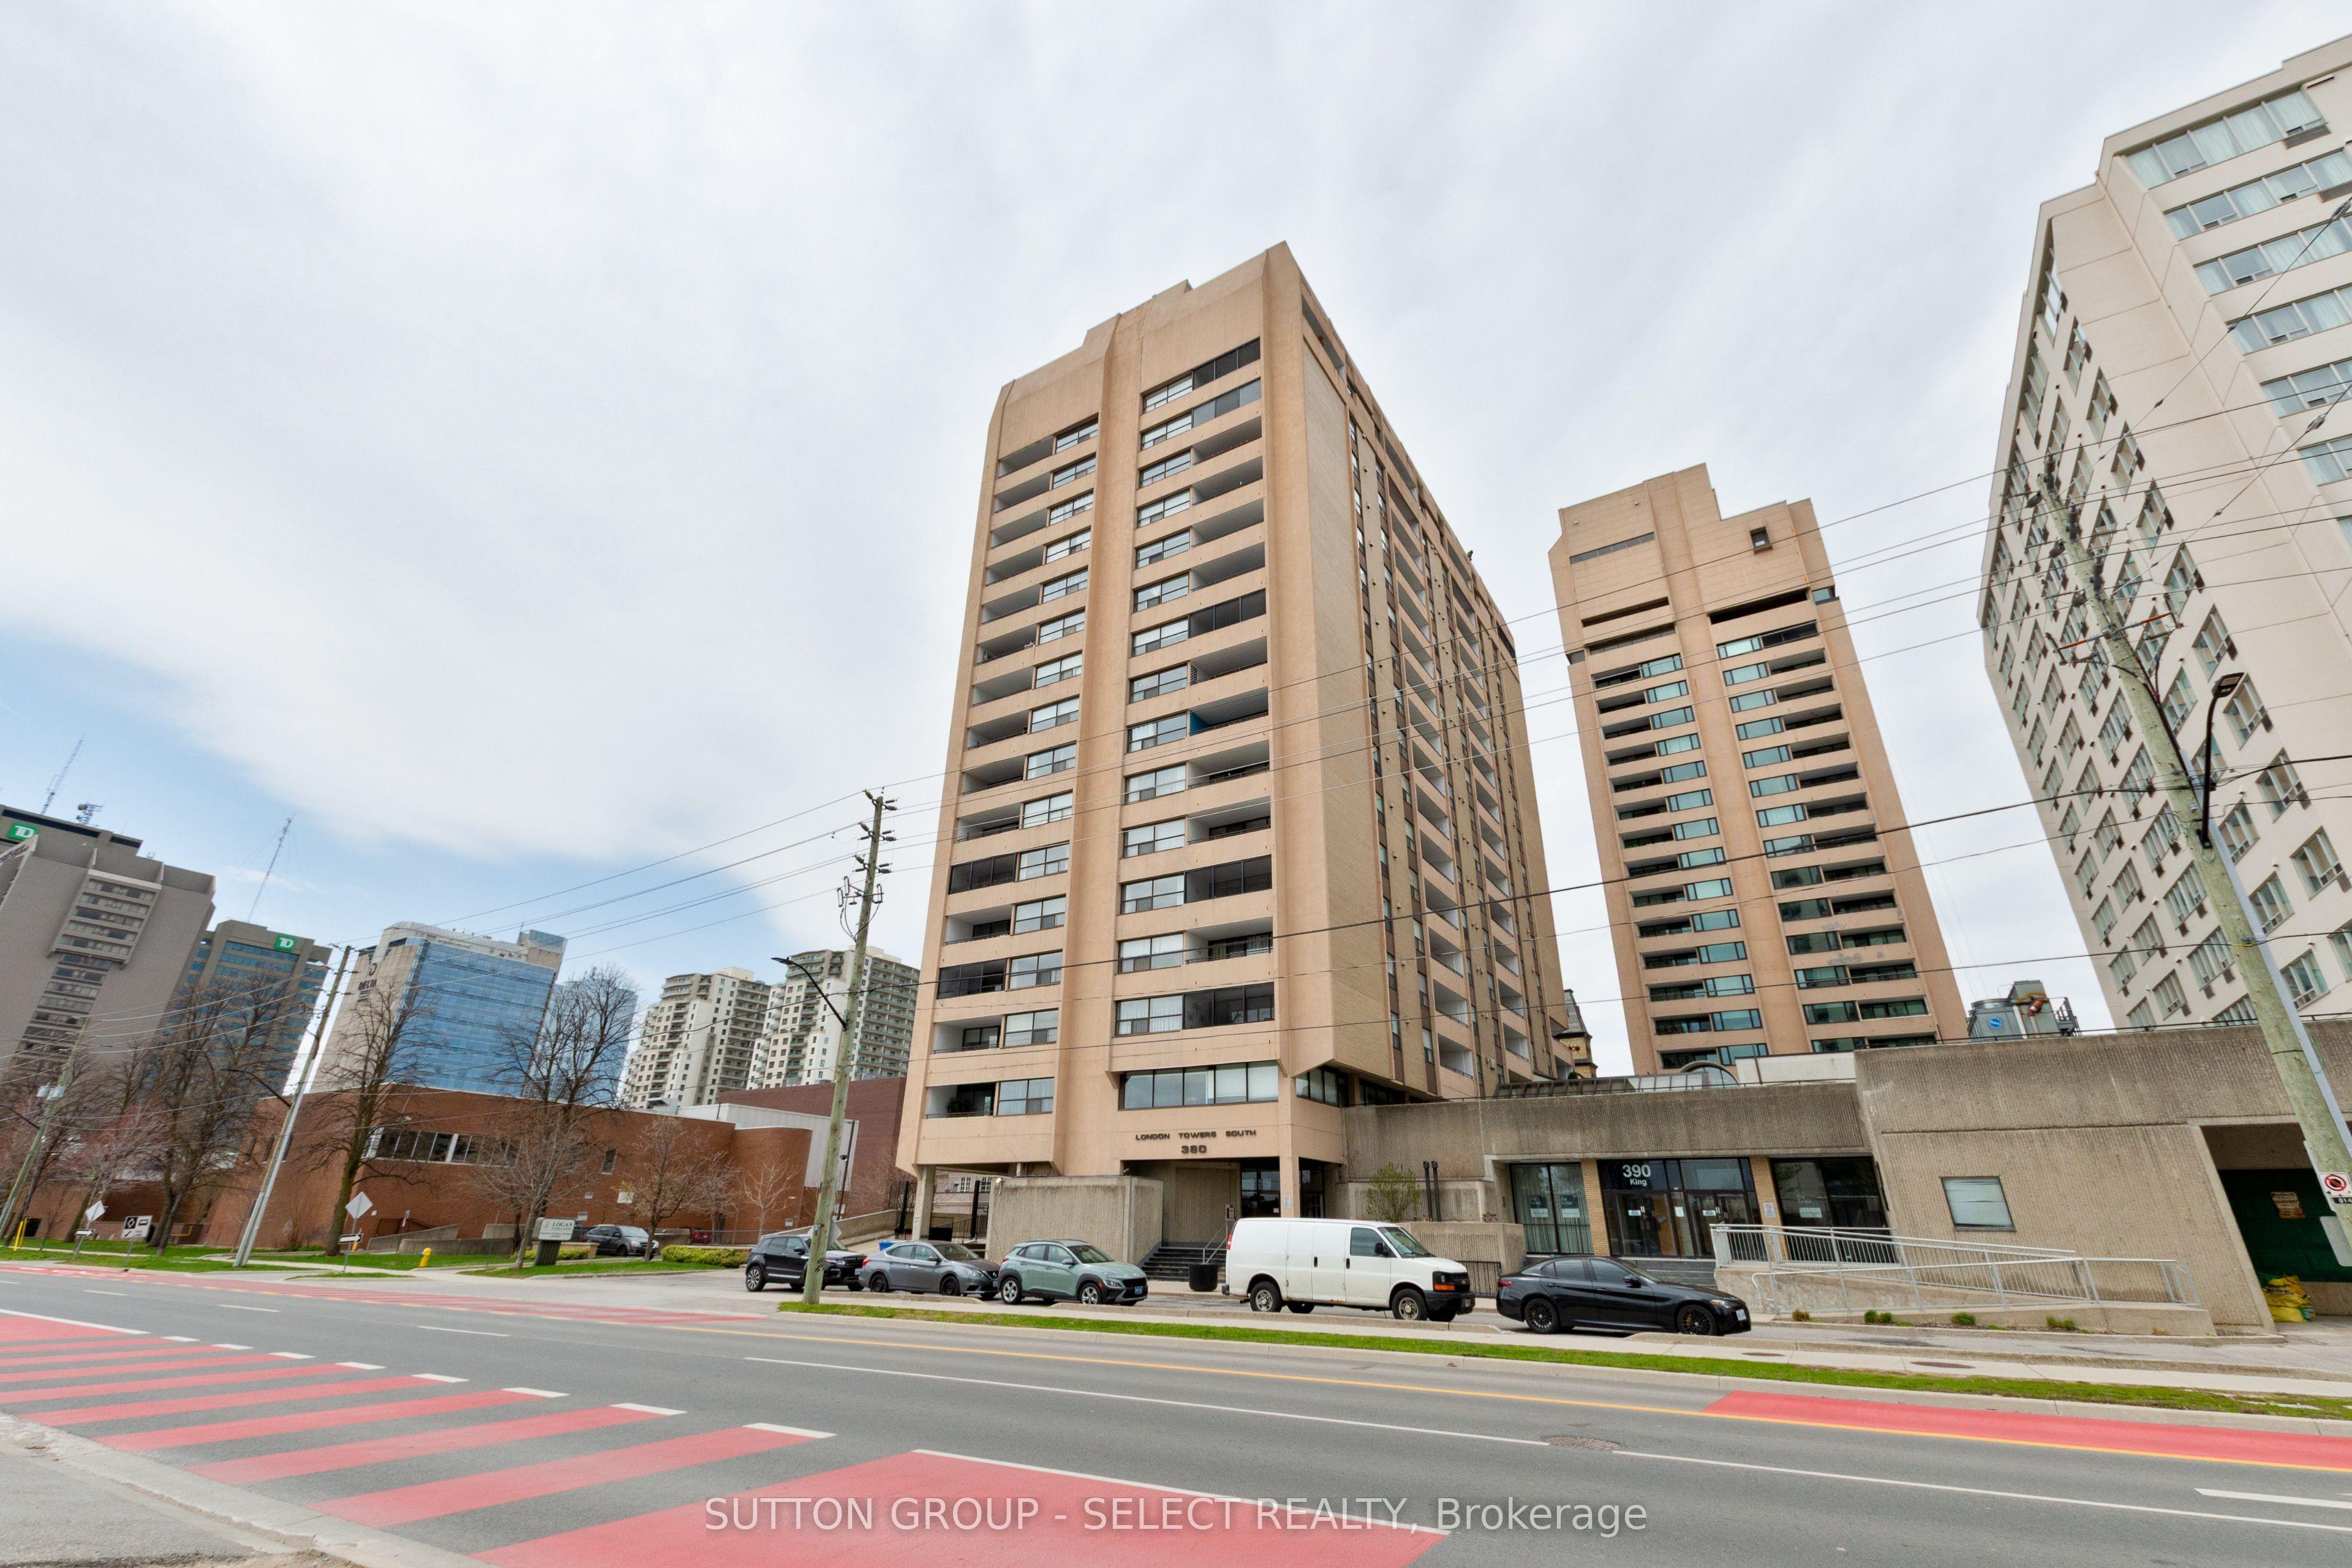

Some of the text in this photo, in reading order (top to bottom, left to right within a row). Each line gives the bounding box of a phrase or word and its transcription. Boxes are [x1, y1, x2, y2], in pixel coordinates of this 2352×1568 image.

[15, 825, 34, 838] TD
[279, 937, 294, 948] TD
[1181, 1145, 1207, 1154] 380
[1623, 1164, 1651, 1177] 390
